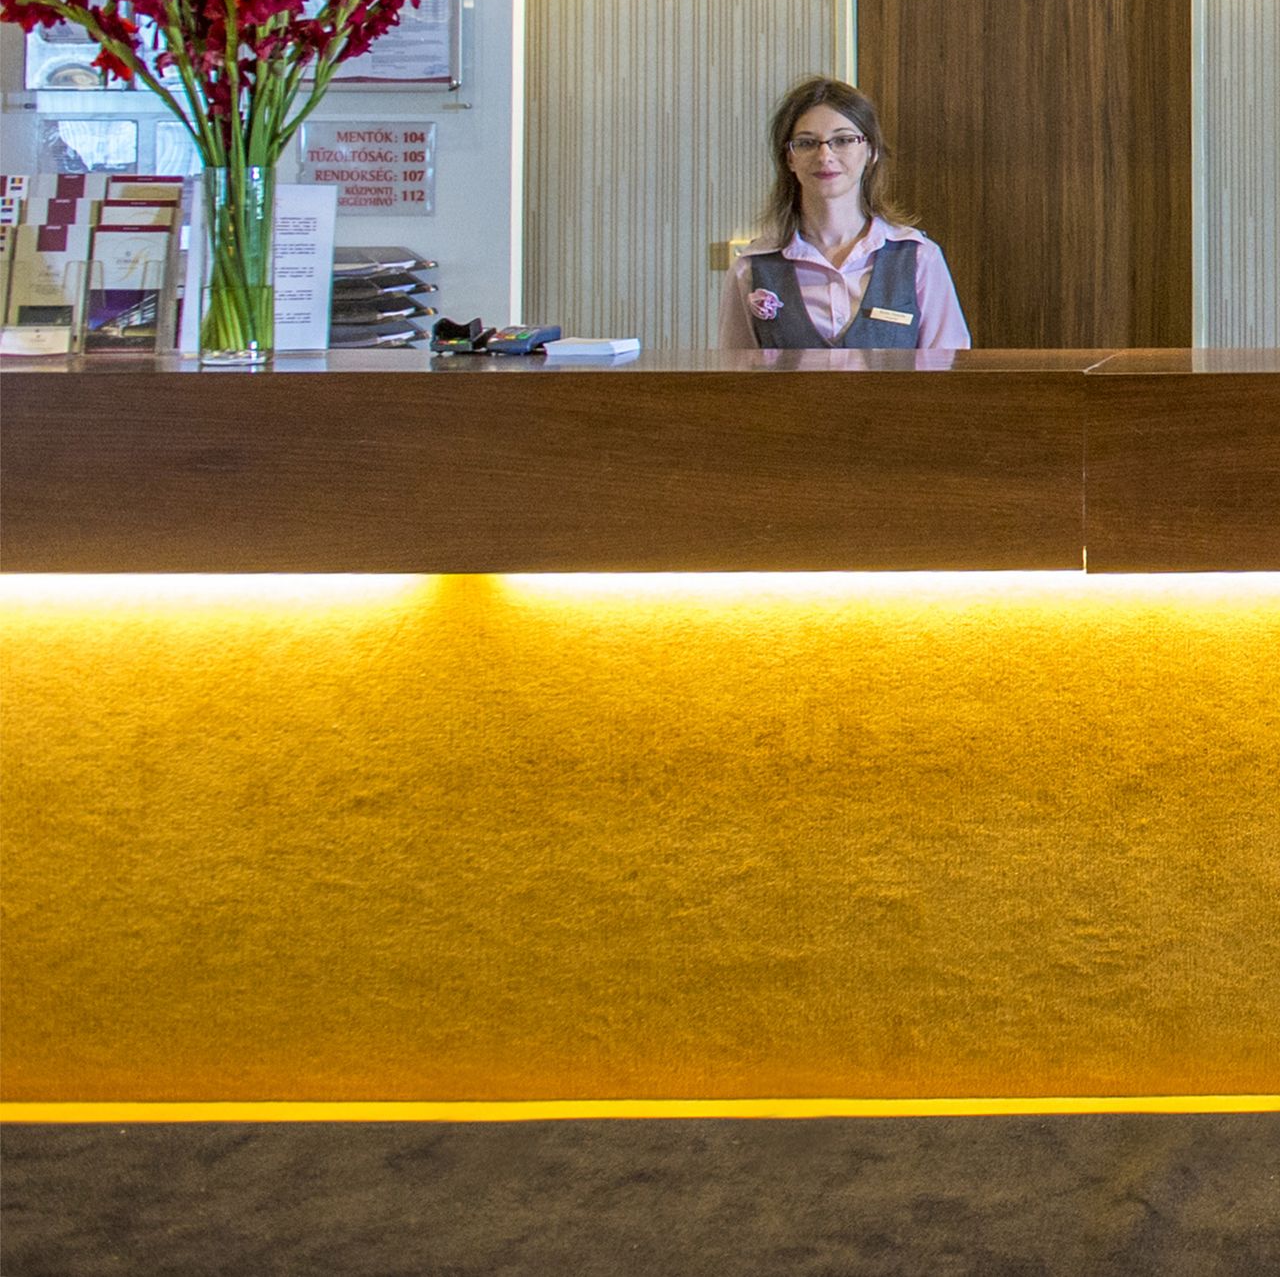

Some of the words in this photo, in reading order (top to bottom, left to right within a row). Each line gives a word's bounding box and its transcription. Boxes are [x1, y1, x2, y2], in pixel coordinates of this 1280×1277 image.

[403, 131, 425, 143] 104
[403, 151, 425, 162] 105
[403, 170, 425, 182] 107
[402, 190, 425, 202] 112
